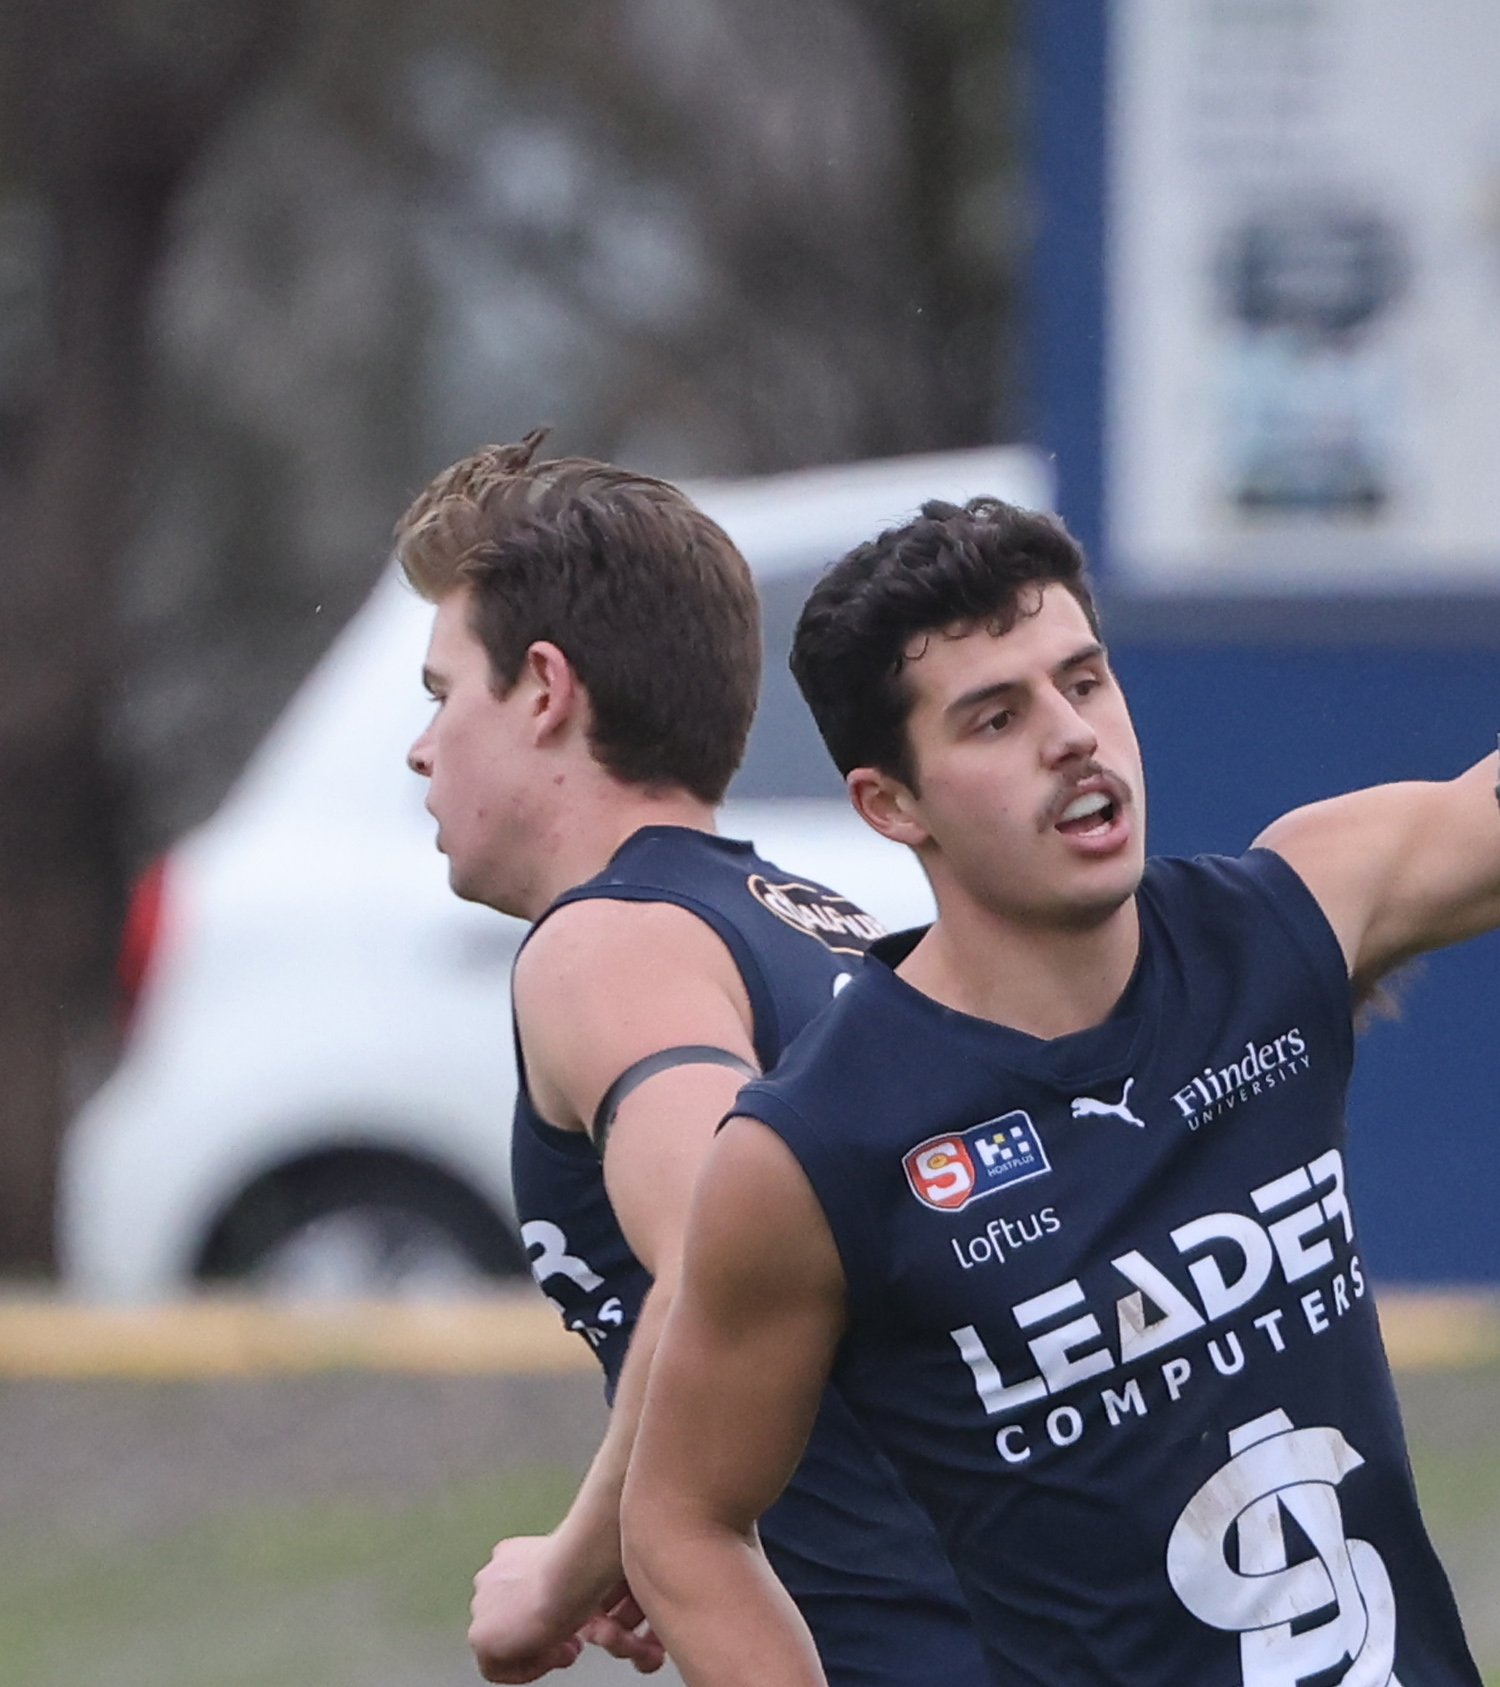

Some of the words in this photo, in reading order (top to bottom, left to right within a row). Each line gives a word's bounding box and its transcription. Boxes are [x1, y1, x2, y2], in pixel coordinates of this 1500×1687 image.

[1170, 1027, 1306, 1117] Flinders
[1188, 1055, 1311, 1132] UNIVERSITY
[951, 1207, 1061, 1270] loftus
[951, 1149, 1354, 1415] LEADER
[994, 1255, 1366, 1464] COMPUTERS
